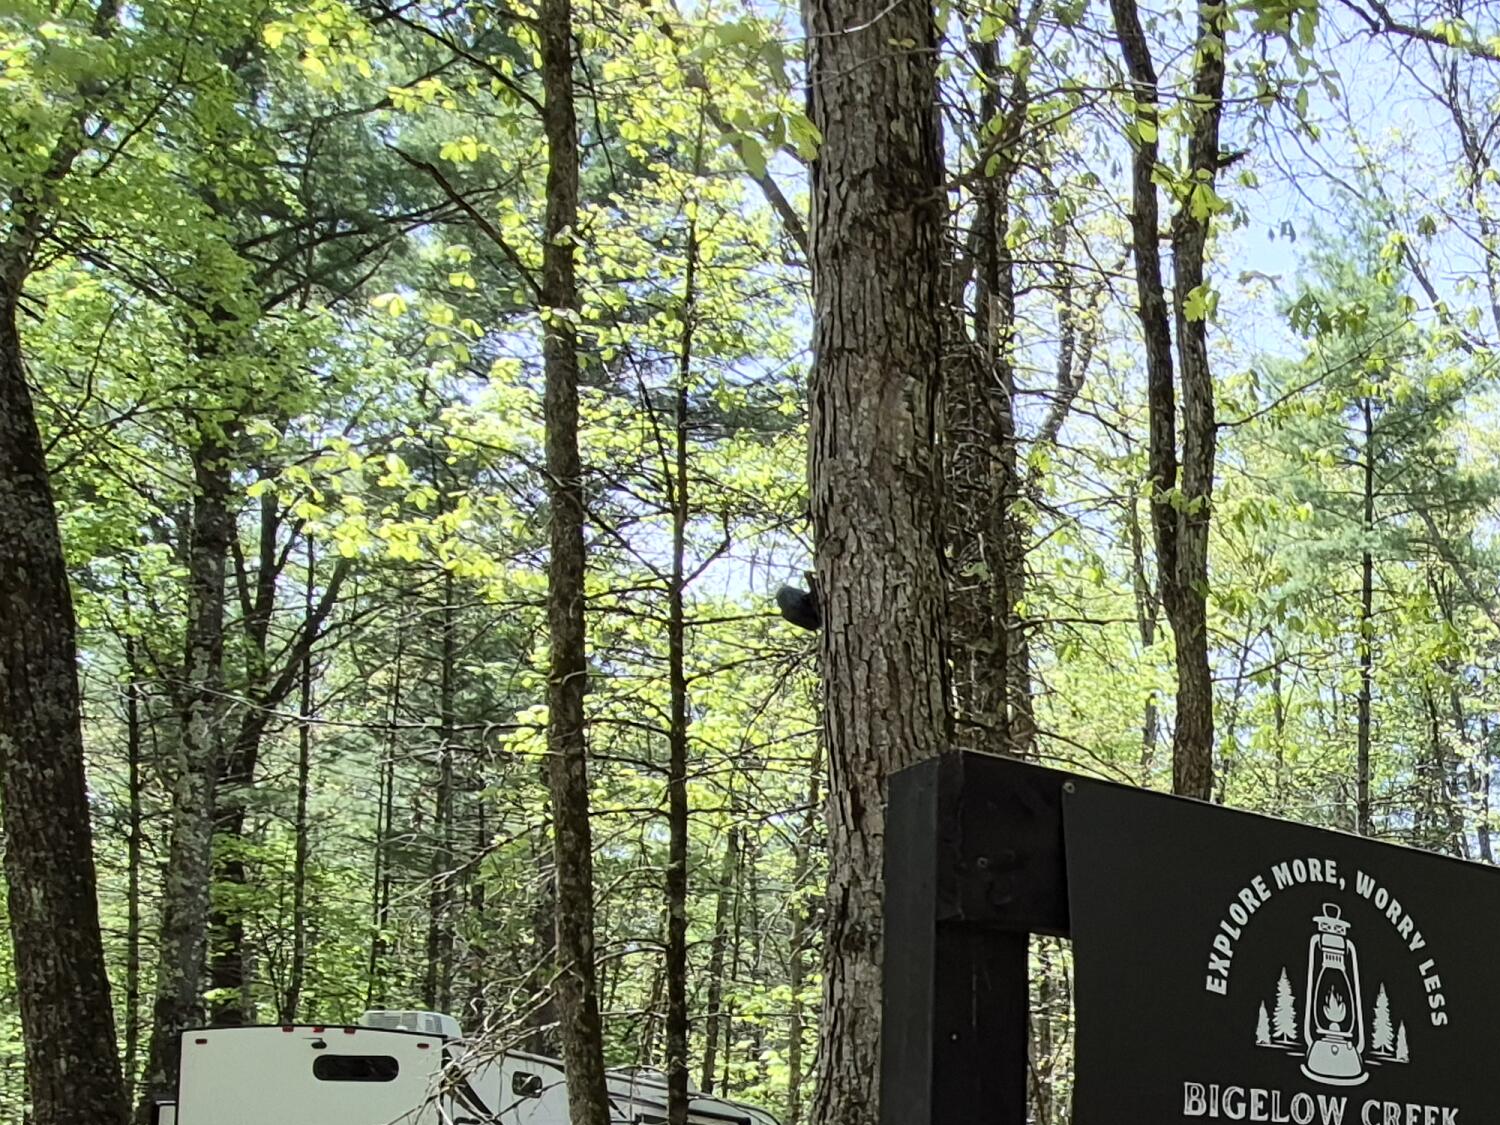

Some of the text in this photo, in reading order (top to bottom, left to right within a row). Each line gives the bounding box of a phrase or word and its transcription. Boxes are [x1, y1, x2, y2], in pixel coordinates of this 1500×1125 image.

[1206, 857, 1448, 1027] EXPLORE MORE, WORRY LESS
